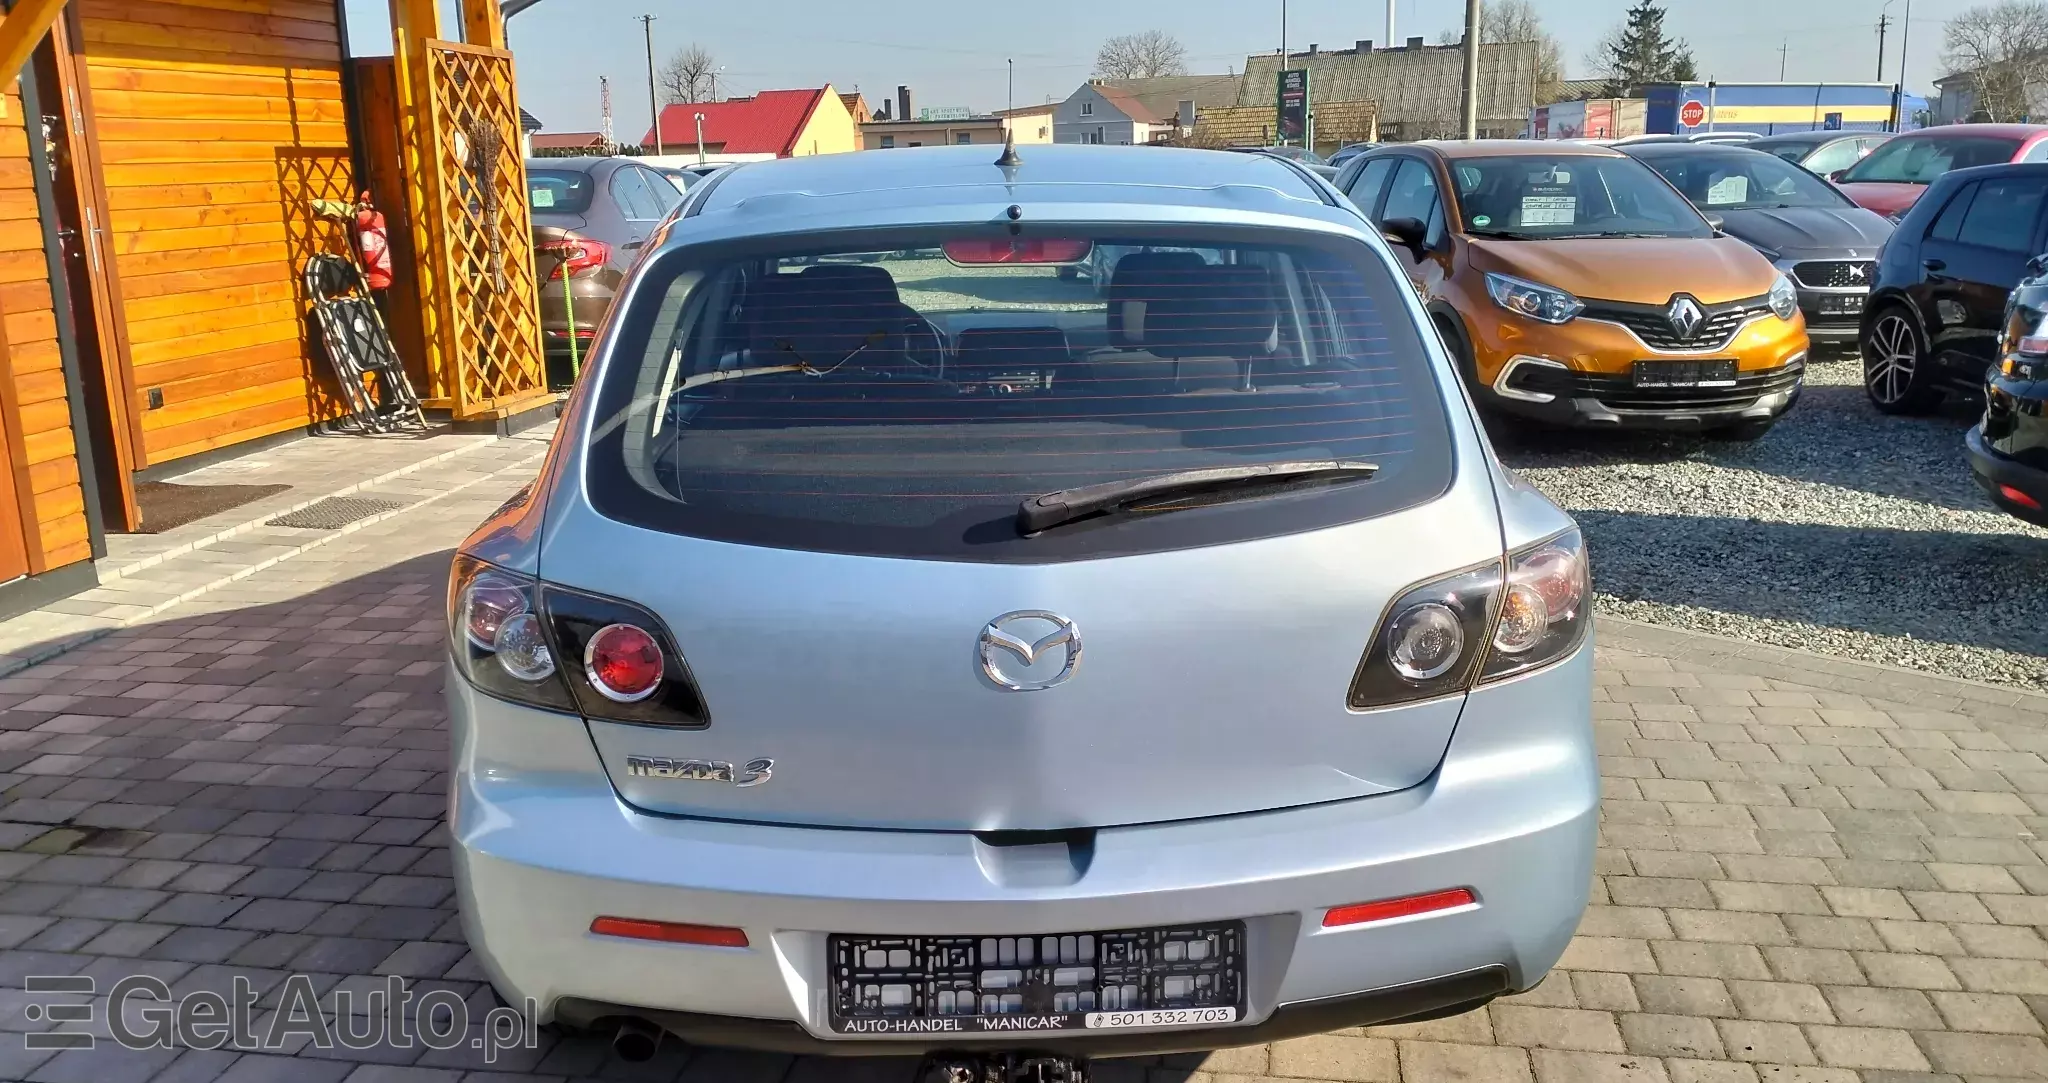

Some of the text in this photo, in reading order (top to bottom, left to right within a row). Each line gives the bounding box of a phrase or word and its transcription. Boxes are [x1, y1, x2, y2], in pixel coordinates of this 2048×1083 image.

[1683, 109, 1703, 119] STOP
[736, 756, 775, 788] 3
[844, 1015, 1068, 1032] AUTO-HANDEL "MANICAR"
[1110, 1008, 1229, 1026] 501 332 703
